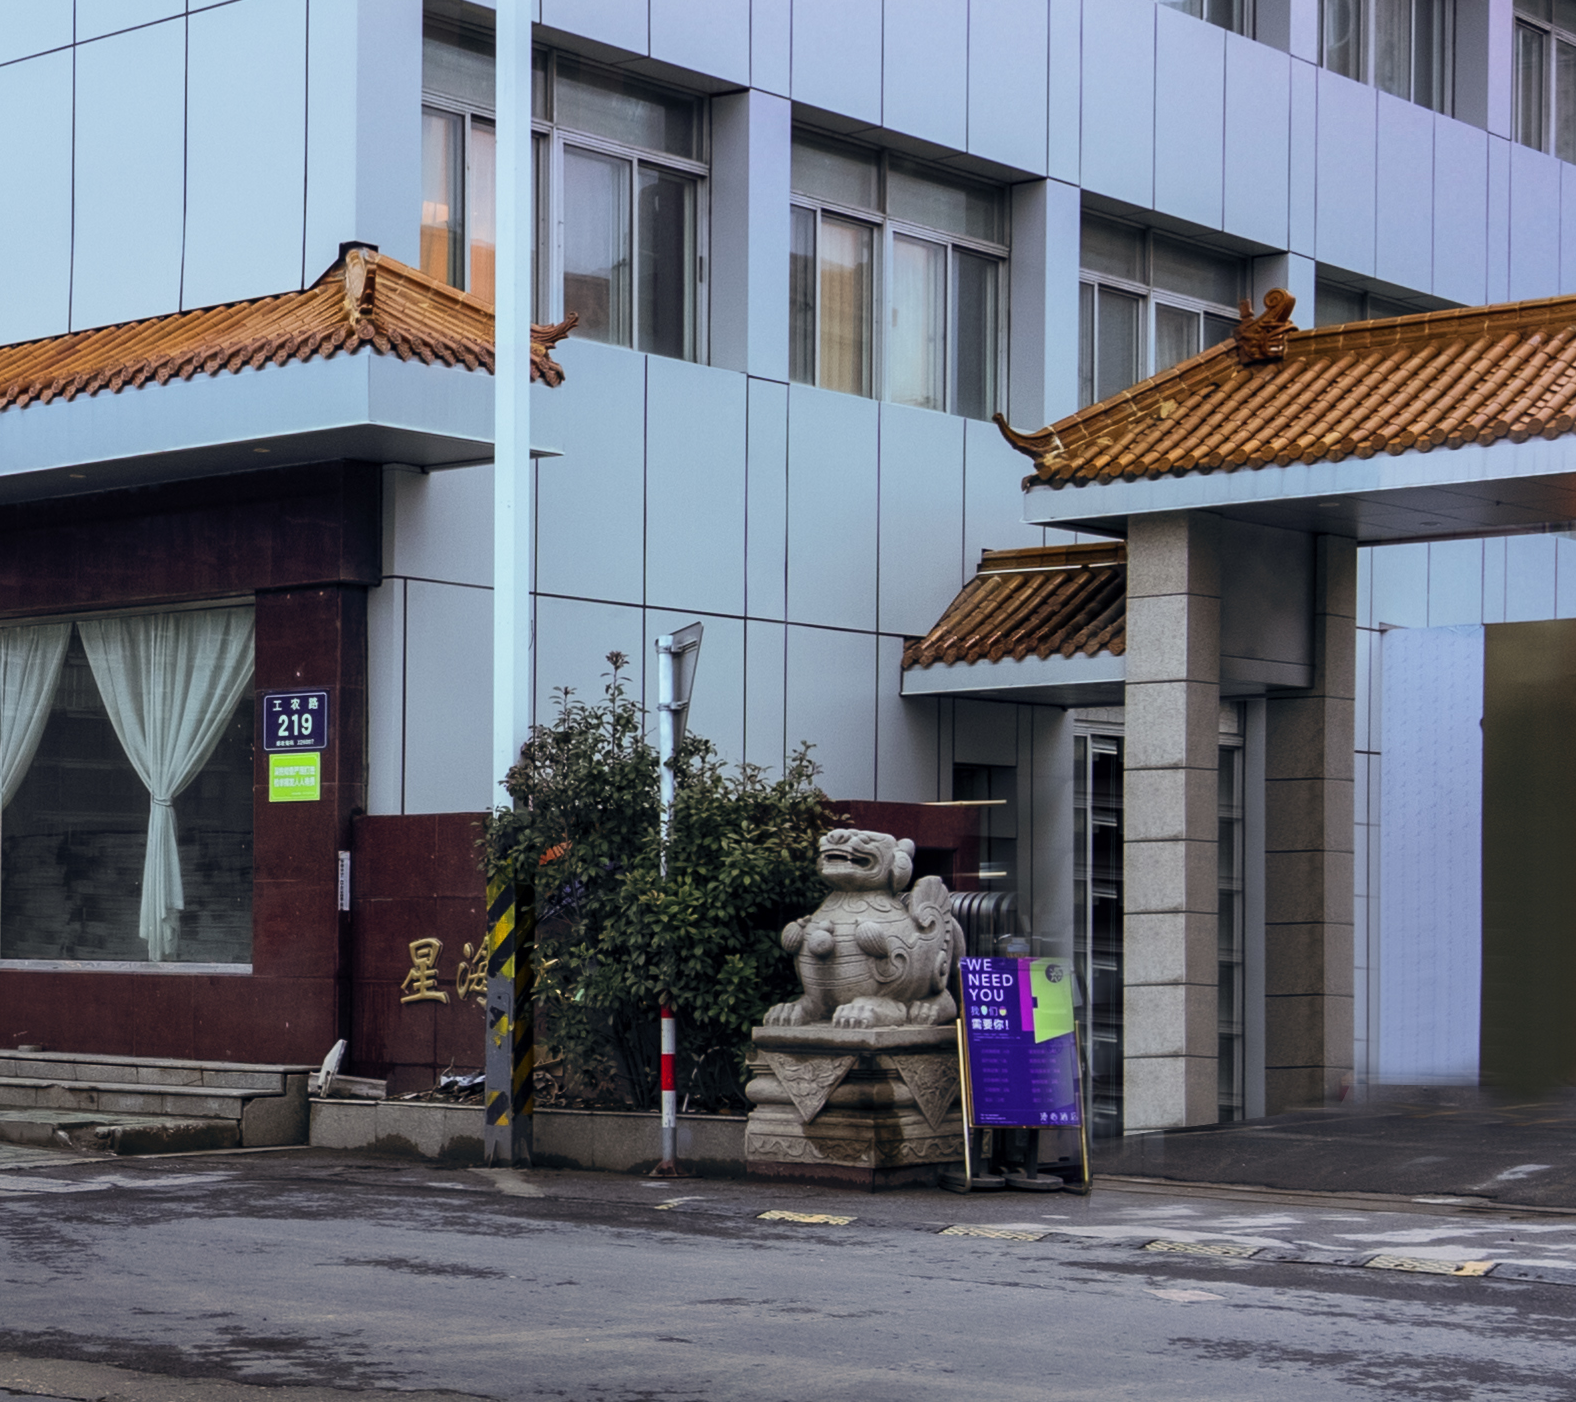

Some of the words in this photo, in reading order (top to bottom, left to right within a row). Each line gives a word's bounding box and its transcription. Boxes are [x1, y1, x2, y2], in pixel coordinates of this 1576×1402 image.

[272, 697, 319, 711] 工农路
[278, 713, 312, 737] 219
[966, 958, 993, 971] WE
[968, 973, 1013, 987] NEED
[968, 988, 1004, 1002] YOU
